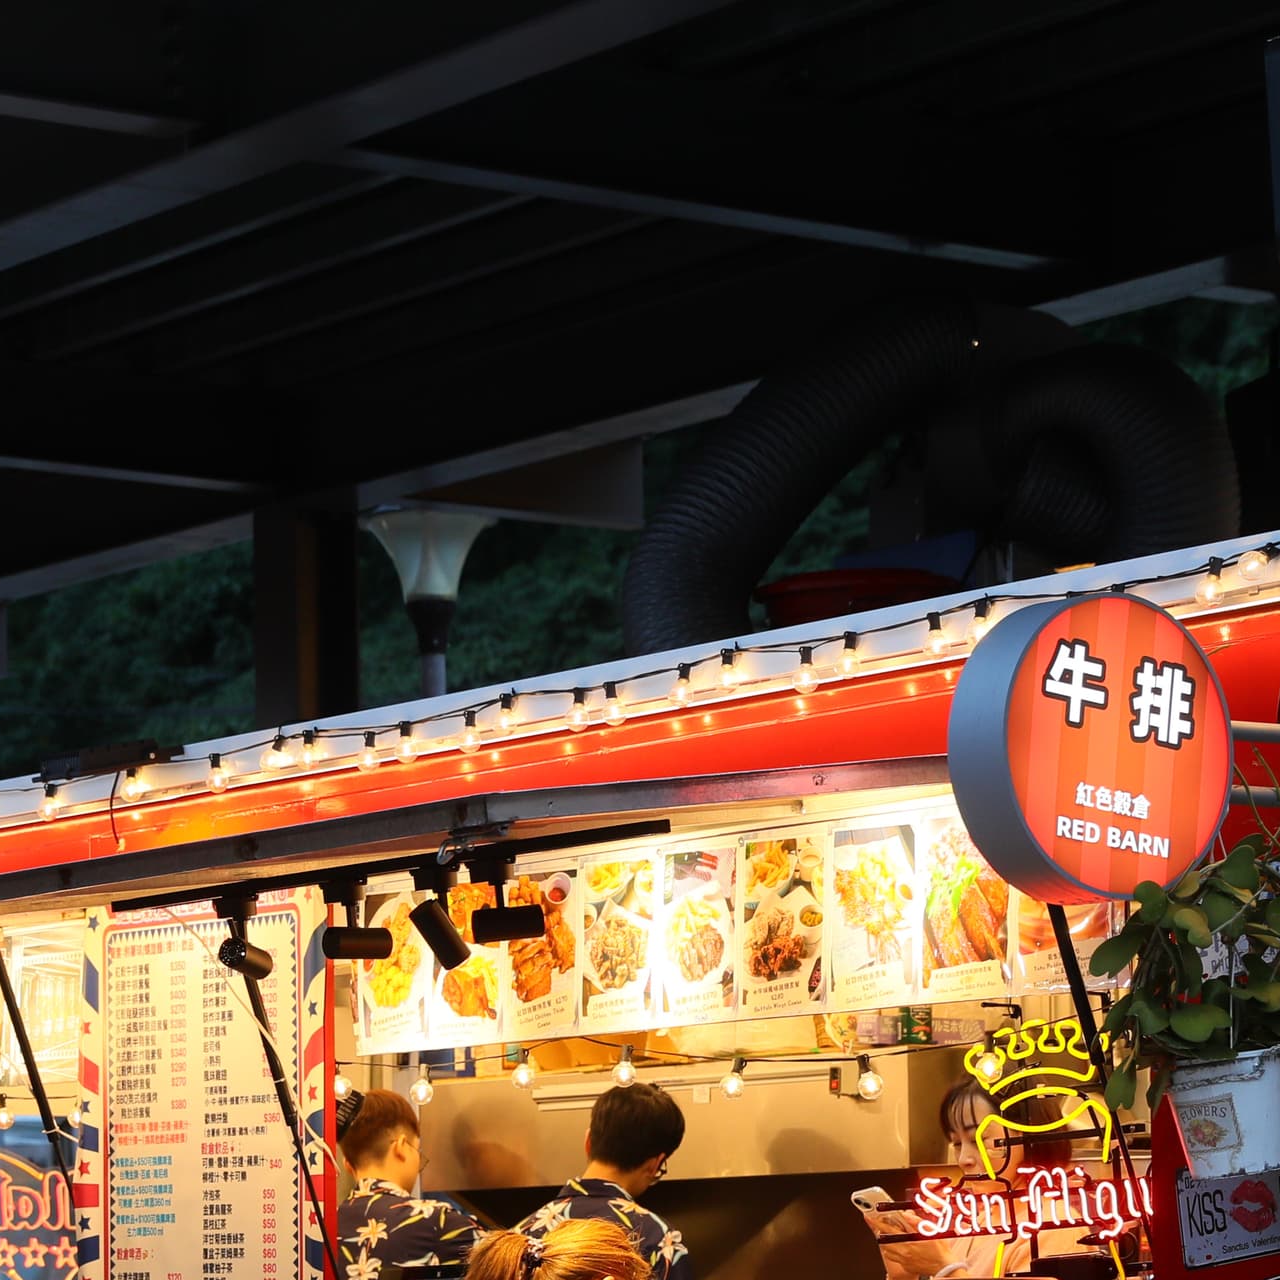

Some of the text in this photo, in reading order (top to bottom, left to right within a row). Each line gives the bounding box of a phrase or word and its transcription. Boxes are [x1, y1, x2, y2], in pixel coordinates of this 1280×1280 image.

[1043, 637, 1195, 750] 牛排
[1075, 781, 1151, 820] 紅色穀倉
[1056, 815, 1170, 858] RED BARN
[932, 1019, 972, 1033] ルミホイル
[264, 1113, 280, 1123] $360
[1180, 1103, 1228, 1125] FLOWERS
[269, 1158, 282, 1169] $40
[263, 1189, 275, 1199] $50
[263, 1203, 276, 1214] $50
[915, 1178, 1012, 1236] San
[1187, 1190, 1228, 1238] KISS
[263, 1218, 276, 1229] $50
[263, 1233, 277, 1244] $60
[263, 1248, 277, 1258] $60
[1222, 1241, 1250, 1255] Sanctus
[263, 1263, 277, 1273] $80
